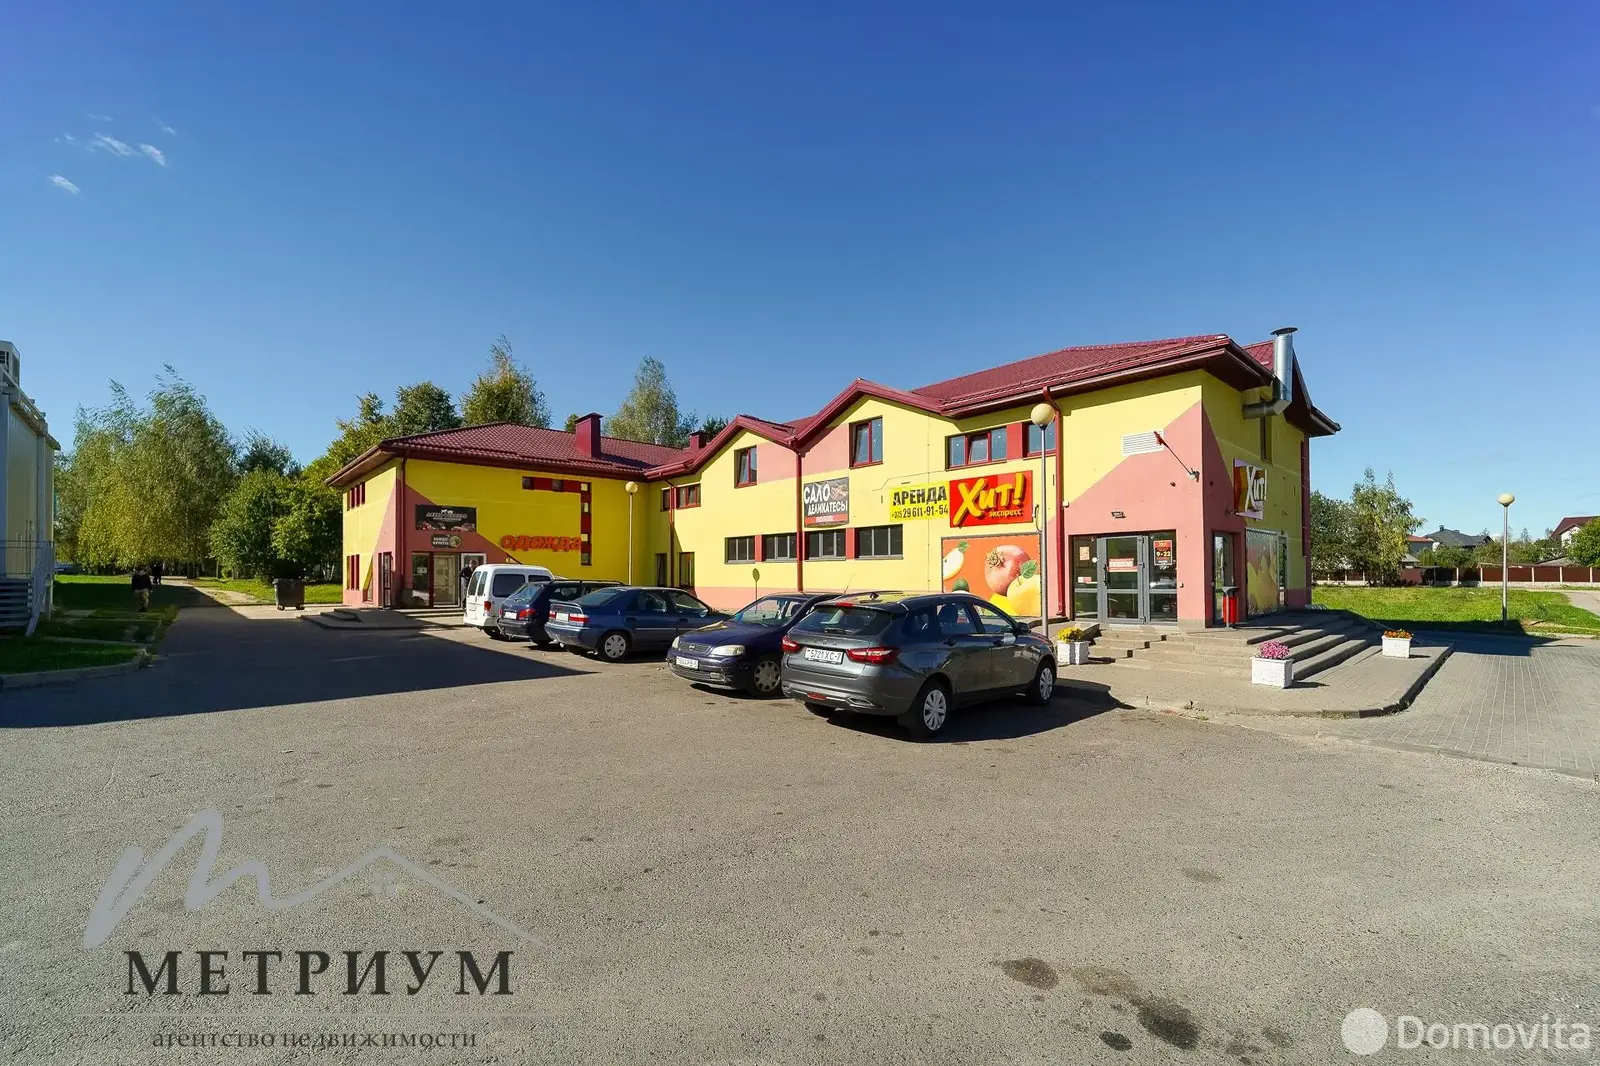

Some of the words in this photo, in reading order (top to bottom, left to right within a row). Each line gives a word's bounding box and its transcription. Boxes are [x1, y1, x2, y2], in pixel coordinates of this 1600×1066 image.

[803, 483, 831, 504] САЛО
[893, 486, 948, 506] АРЕНДА
[952, 472, 1026, 526] Хит!
[808, 500, 848, 516] ДЕЛИКАТЕСЫ
[988, 508, 1023, 518] экспресс
